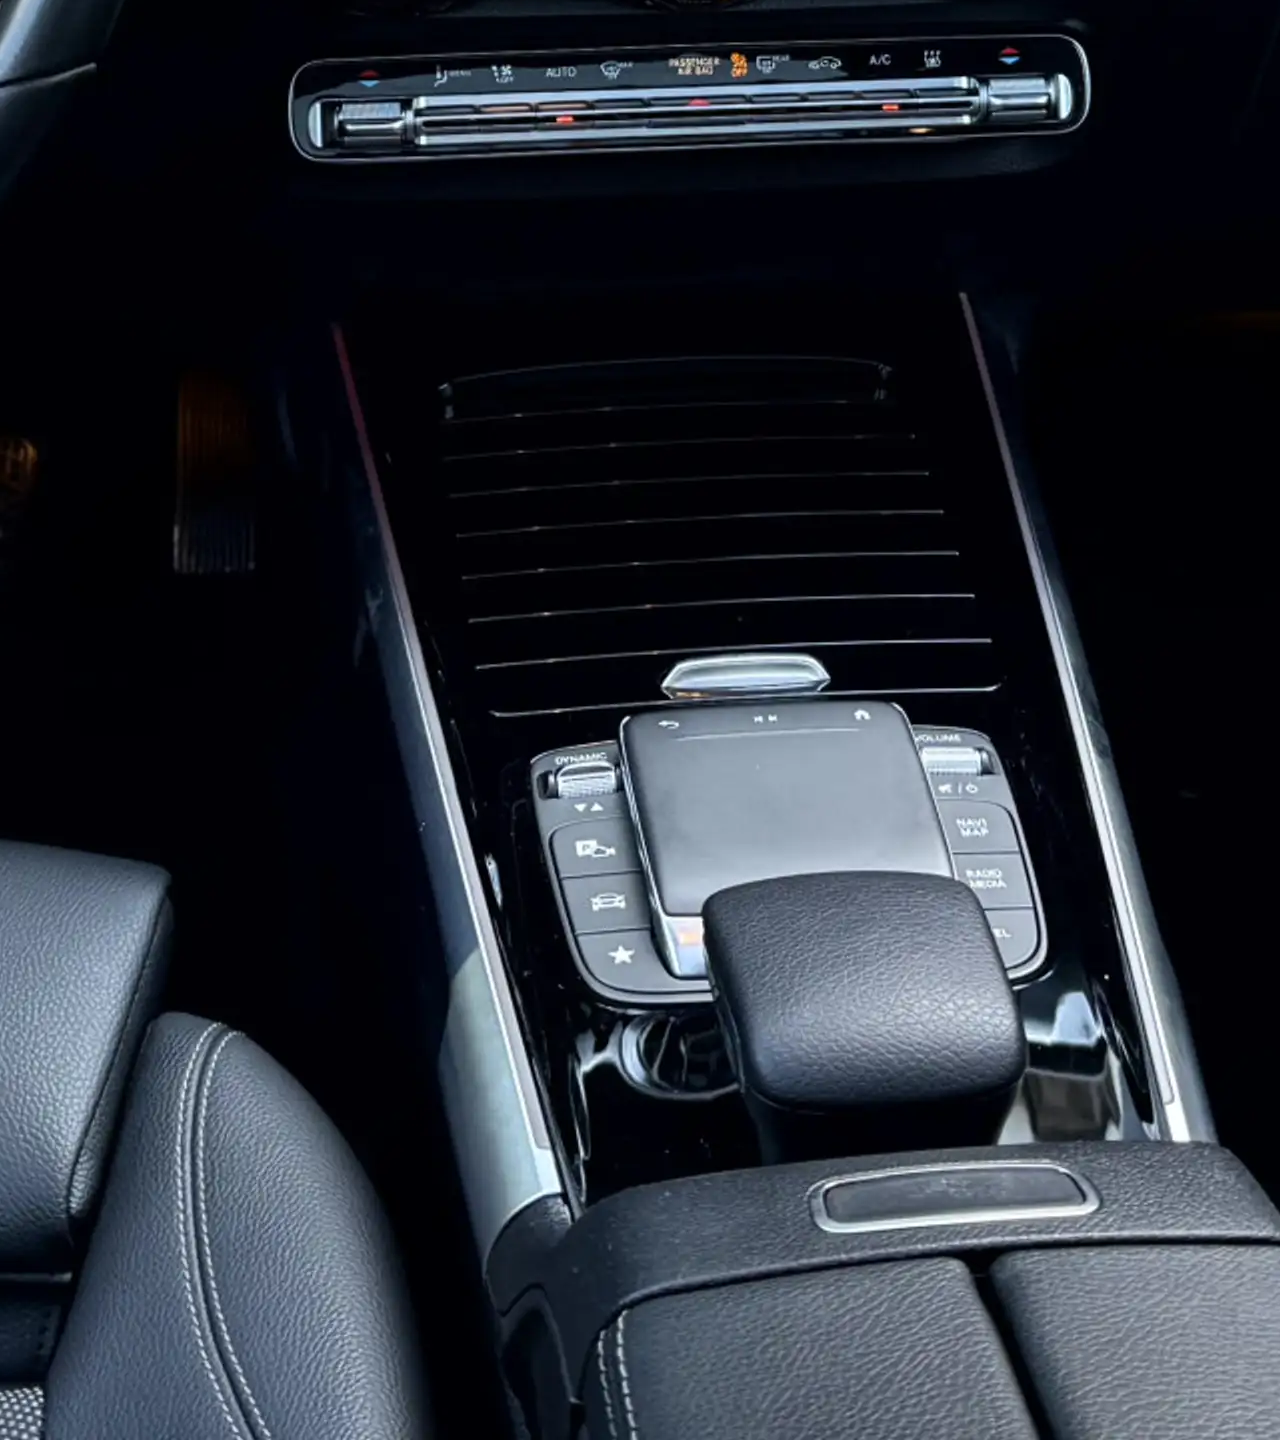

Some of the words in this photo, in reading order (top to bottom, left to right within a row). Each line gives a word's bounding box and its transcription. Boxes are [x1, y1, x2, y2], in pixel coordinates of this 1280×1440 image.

[869, 54, 891, 66] A/C
[546, 67, 576, 78] AUTO
[915, 732, 962, 742] VOLUME
[554, 752, 607, 765] DYNAMIC
[956, 817, 988, 828] NAVI
[960, 827, 989, 837] MAP
[965, 868, 1003, 879] RADIO
[968, 877, 1007, 889] MEDIA
[993, 927, 1012, 938] EL
